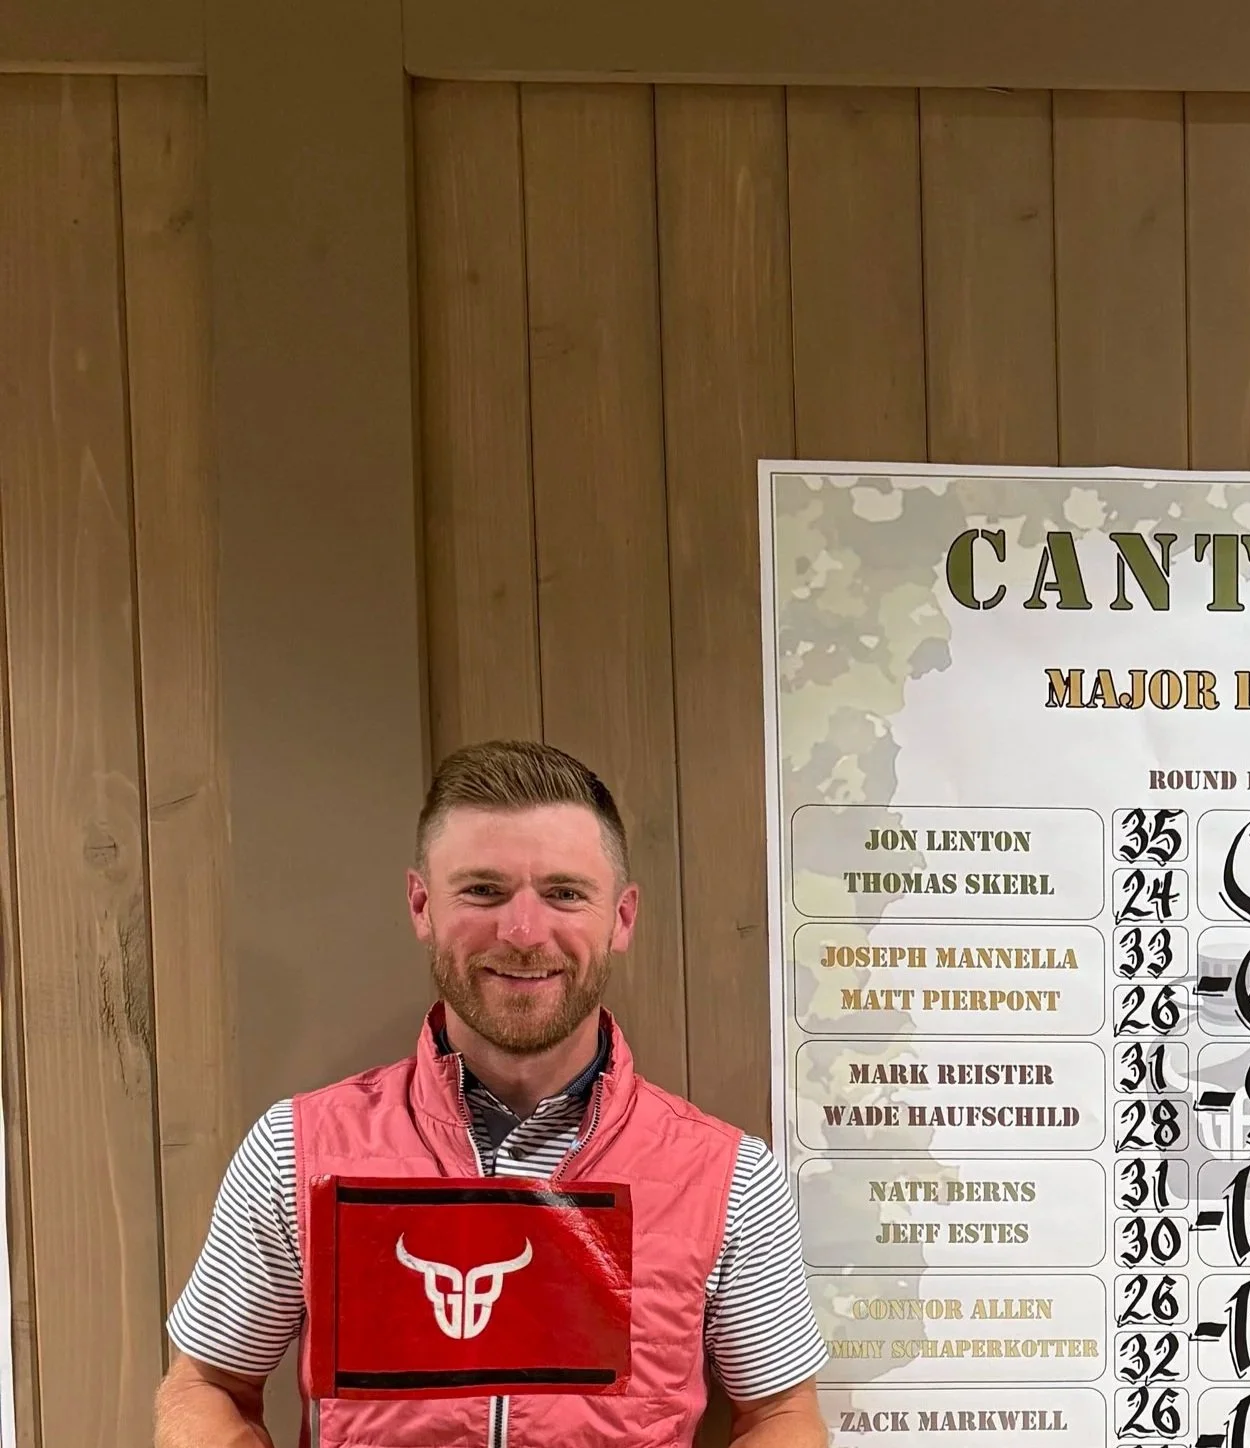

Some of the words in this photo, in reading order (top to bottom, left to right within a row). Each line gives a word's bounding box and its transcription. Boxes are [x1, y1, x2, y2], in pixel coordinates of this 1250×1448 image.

[1045, 667, 1219, 712] MAJOR
[1149, 770, 1237, 791] ROUND
[864, 828, 917, 851] JON
[926, 829, 1031, 852] LENTON
[1119, 808, 1184, 866] 35
[843, 872, 957, 894] THOMAS
[965, 873, 1055, 896] SKERL
[1115, 869, 1180, 924] 24
[820, 946, 927, 968] JOSEPH
[936, 947, 1079, 970] MANNELLA
[1119, 928, 1173, 979] 33
[840, 988, 915, 1010] MATT
[922, 989, 1061, 1012] PIERPONT
[1114, 985, 1180, 1037] 26
[849, 1063, 929, 1085] MARK
[937, 1063, 1054, 1085] REISTER
[1119, 1042, 1165, 1094] 31
[823, 1105, 898, 1127] WADE
[907, 1105, 1080, 1128] HAUFSCHILD
[1115, 1099, 1181, 1152] 28
[868, 1180, 939, 1202] NATE
[946, 1181, 1037, 1202] BERNS
[1120, 1158, 1169, 1213] 31
[875, 1222, 941, 1244] JEFF
[948, 1222, 1029, 1244] ESTES
[1121, 1216, 1182, 1268] 30
[852, 1298, 963, 1320] CONNOR
[970, 1298, 1053, 1320] ALLEN
[1117, 1274, 1179, 1327] 26
[891, 1339, 1099, 1359] SCHAPERKOTTER
[1119, 1331, 1180, 1386] 32
[840, 1410, 910, 1432] ZACK
[918, 1410, 1068, 1432] MARKWELL
[1117, 1386, 1180, 1439] 26
